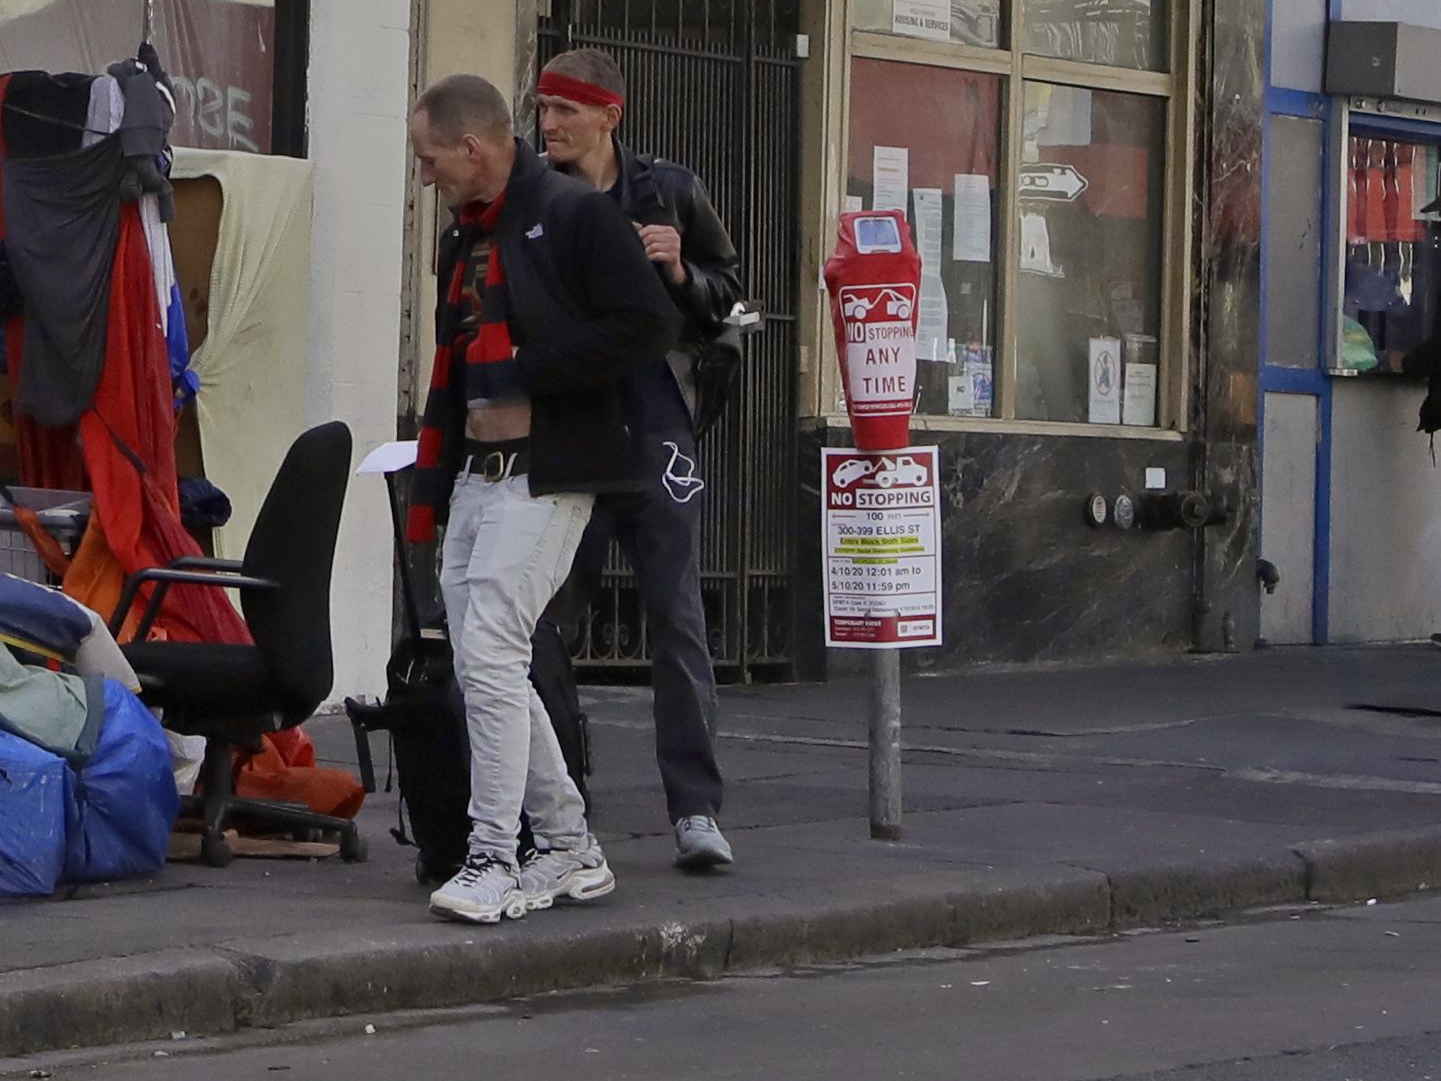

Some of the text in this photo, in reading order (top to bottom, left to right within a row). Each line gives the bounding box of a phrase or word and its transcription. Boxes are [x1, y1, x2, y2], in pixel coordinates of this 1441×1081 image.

[847, 322, 864, 341] NO
[865, 347, 900, 365] ANY
[863, 376, 906, 394] TIME
[832, 491, 931, 505] NO STOPPING
[866, 512, 883, 520] 100
[838, 524, 920, 535] 300-399 ELLIS ST
[867, 568, 892, 576] 12:01
[912, 566, 921, 575] to
[867, 582, 893, 591] 11:59
[895, 584, 910, 592] pm
